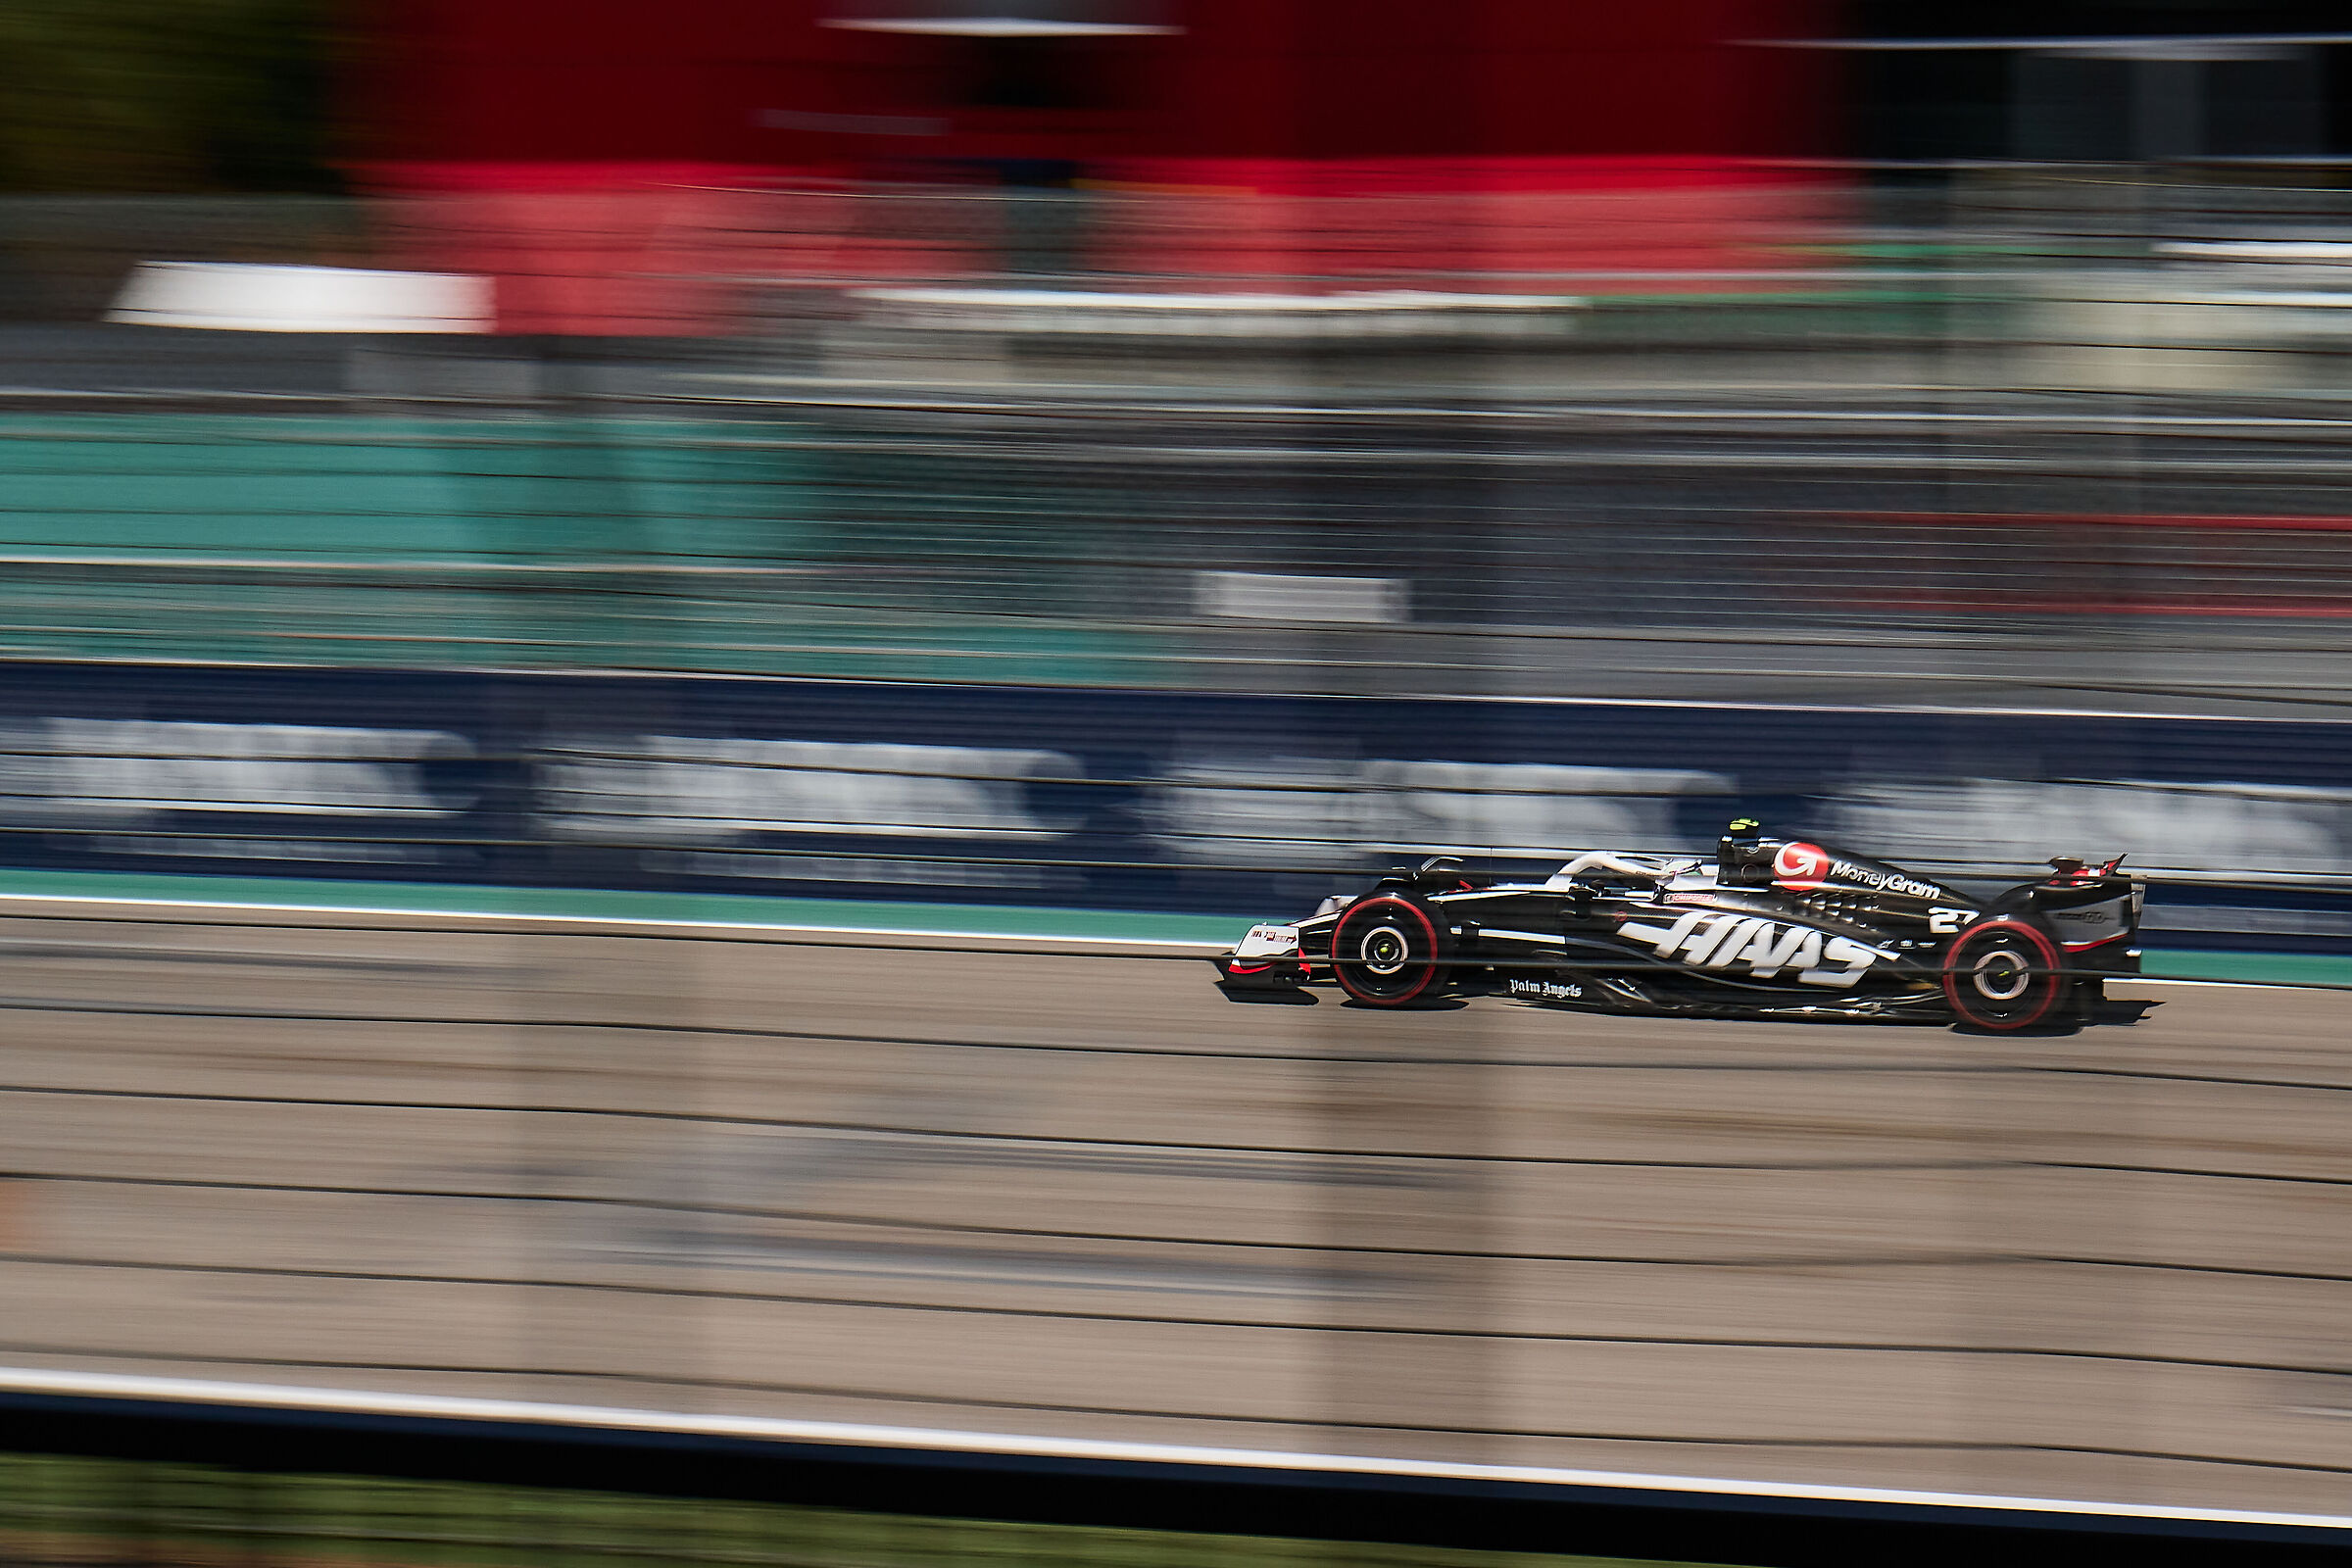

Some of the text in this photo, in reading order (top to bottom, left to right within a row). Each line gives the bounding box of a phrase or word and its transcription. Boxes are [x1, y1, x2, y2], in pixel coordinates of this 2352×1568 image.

[1830, 859, 1941, 900] MoneyGram
[1928, 906, 1980, 933] 27
[1617, 910, 1901, 989] HAAS
[1509, 979, 1582, 999] Palm Angels
